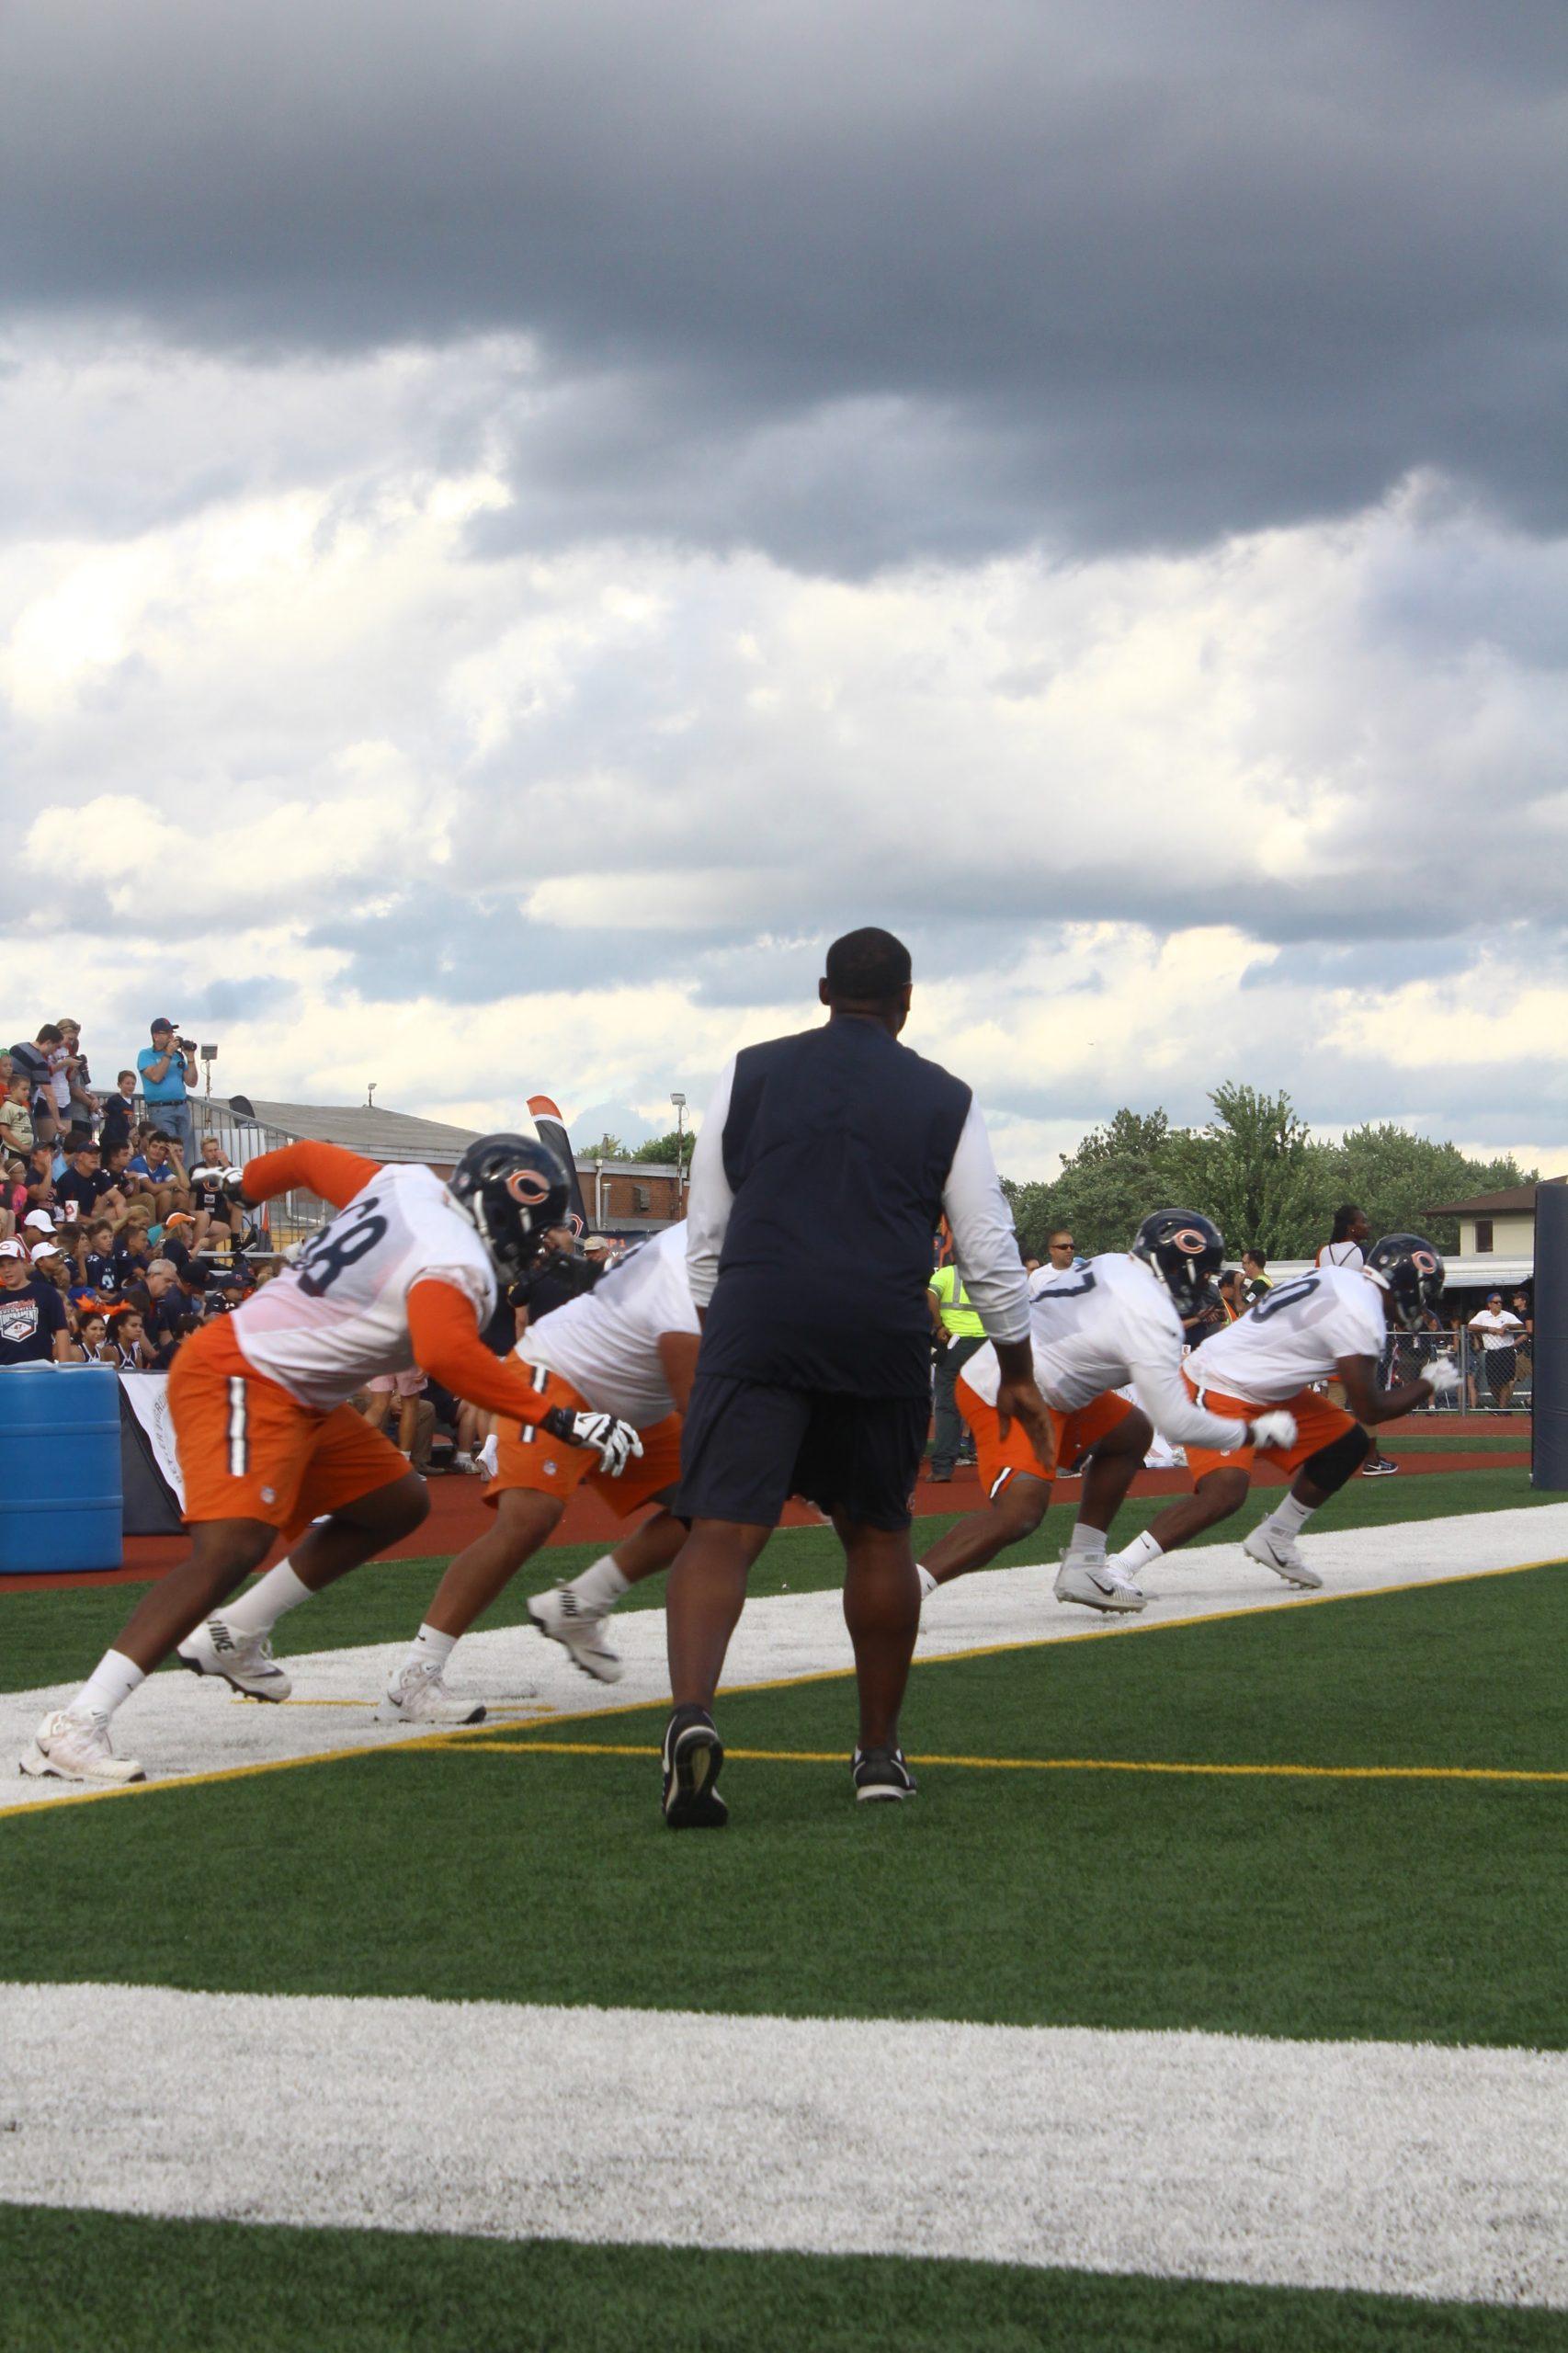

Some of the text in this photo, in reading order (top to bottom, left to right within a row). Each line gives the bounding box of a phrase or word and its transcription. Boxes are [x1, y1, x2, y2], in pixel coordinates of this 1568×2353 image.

[506, 1169, 551, 1205] C
[1173, 1229, 1207, 1254] C
[1028, 1260, 1096, 1302] 7
[1251, 1269, 1321, 1324] 0
